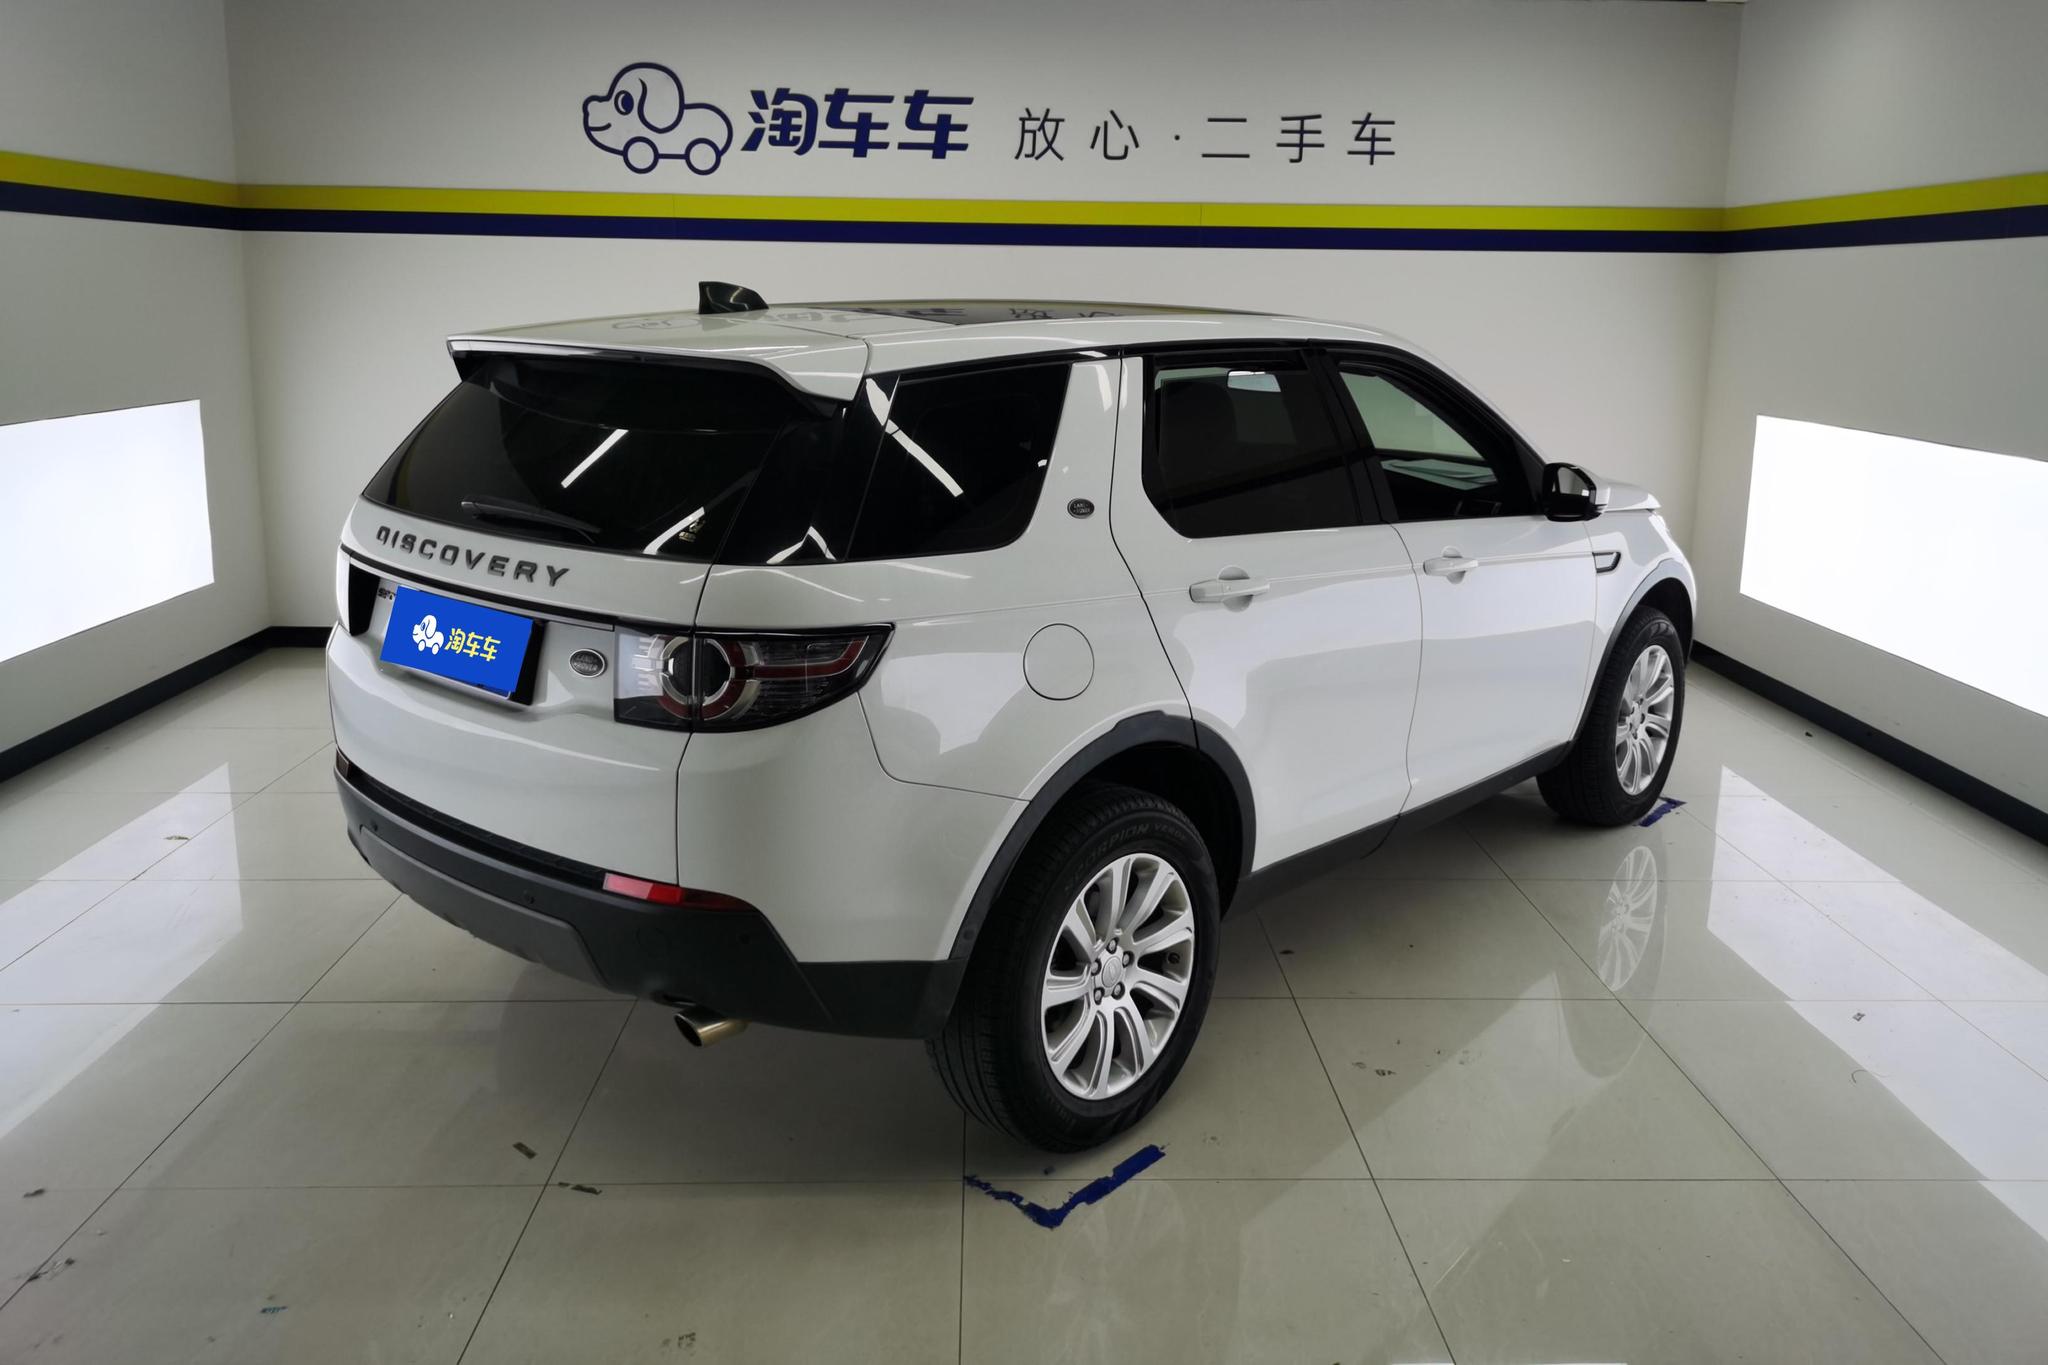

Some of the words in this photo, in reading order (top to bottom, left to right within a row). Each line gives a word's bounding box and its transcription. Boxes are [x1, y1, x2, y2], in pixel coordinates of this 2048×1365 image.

[741, 87, 975, 160] 淘车车
[376, 525, 570, 587] DISCOVERY
